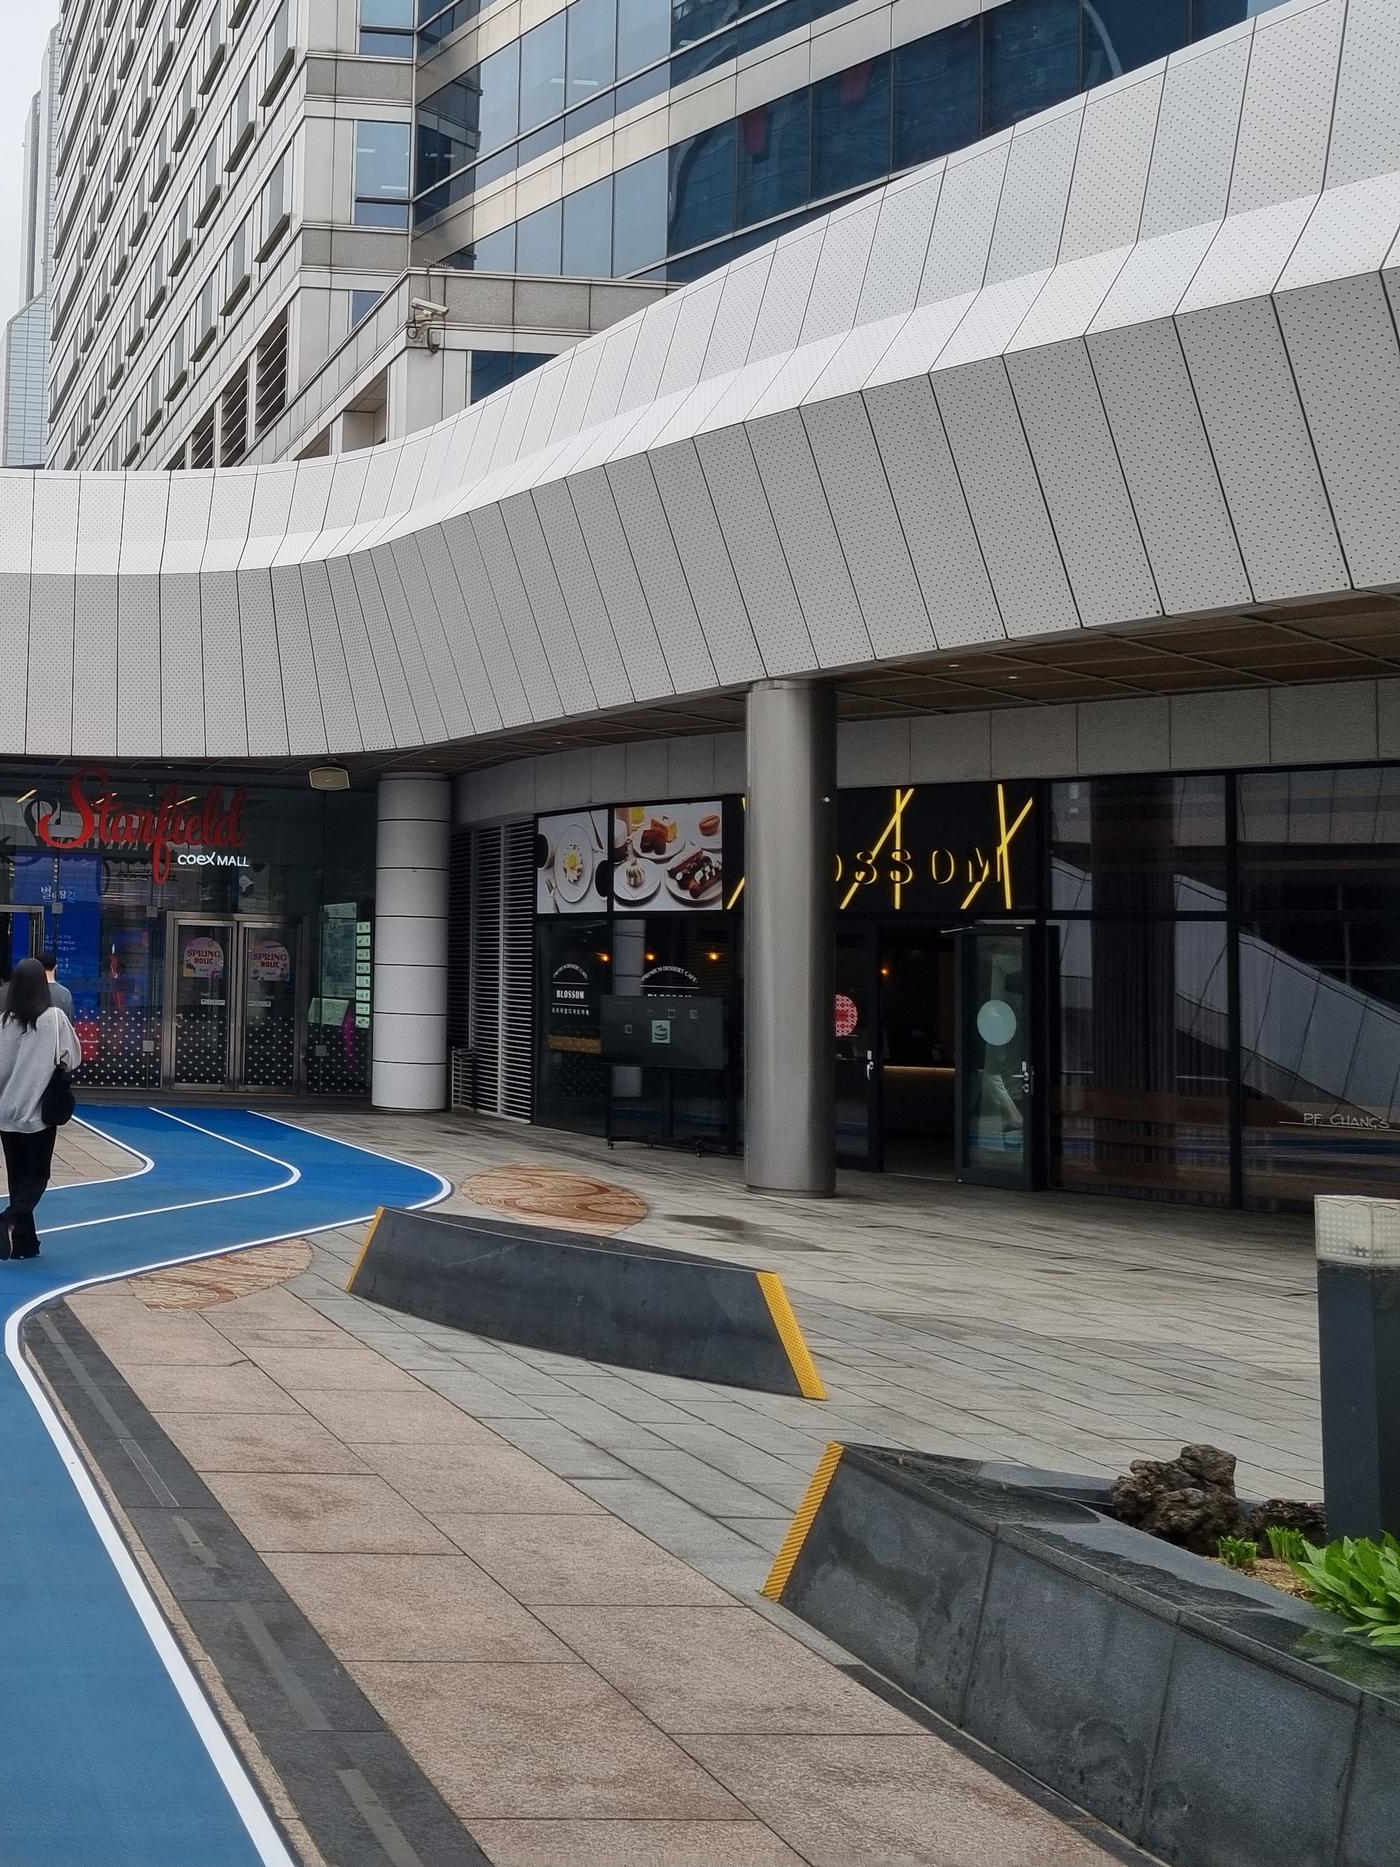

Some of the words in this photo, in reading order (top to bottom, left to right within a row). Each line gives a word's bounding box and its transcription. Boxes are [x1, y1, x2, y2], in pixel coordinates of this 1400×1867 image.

[39, 765, 248, 884] Starfield
[217, 855, 250, 867] MALL
[187, 949, 221, 958] SPRING
[252, 952, 287, 961] SPRING
[194, 957, 213, 965] HOLIC
[260, 960, 280, 968] HOLIC
[556, 989, 585, 999] BLOSSOM
